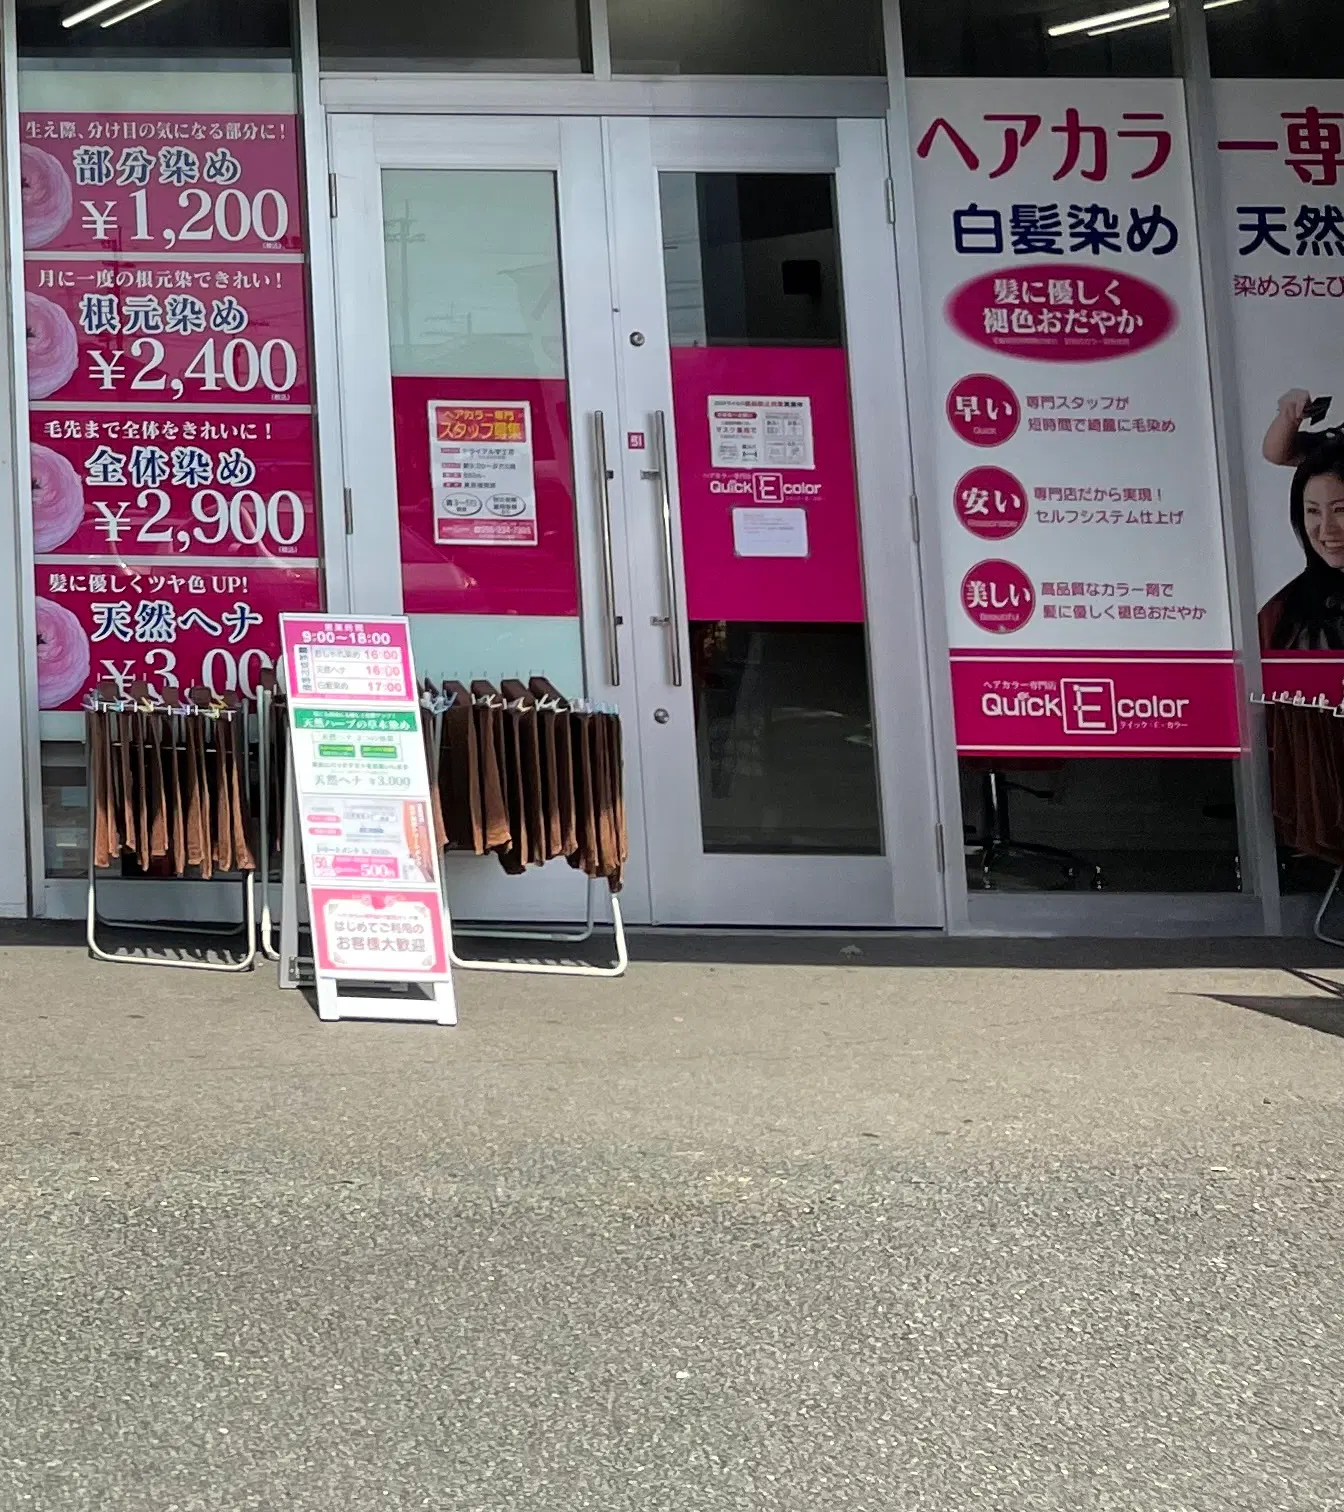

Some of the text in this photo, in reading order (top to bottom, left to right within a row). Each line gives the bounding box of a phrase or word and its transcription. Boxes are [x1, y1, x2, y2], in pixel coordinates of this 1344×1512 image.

[73, 145, 242, 186] 部分染め
[79, 188, 289, 250] ¥1,200
[951, 202, 1178, 256] 白髪染め
[1235, 204, 1344, 256] 天然
[994, 278, 1122, 306] 髪に優しく
[79, 294, 249, 336] 根元染め
[983, 307, 1144, 335] 褪色おだやか
[86, 338, 298, 401] ¥2,400
[954, 395, 1013, 422] 早い
[1026, 395, 1130, 411] 専門スタッフが
[439, 421, 523, 440] スタッフ募集
[85, 446, 256, 487] 全体染め
[710, 480, 753, 494] Quick
[783, 481, 822, 494] color
[962, 487, 1022, 515] 安い
[92, 489, 305, 552] ¥2,900
[1036, 509, 1184, 525] セルフシステム仕上げ
[966, 580, 1032, 609] 美しい
[1041, 582, 1174, 598] 高品質なカラー剤で
[90, 600, 263, 643] 天然ヘナ
[364, 649, 399, 660] 16:00
[365, 665, 401, 677] 16:00
[368, 681, 403, 693] 17:00
[981, 691, 1062, 717] Quick
[1116, 695, 1190, 719] color
